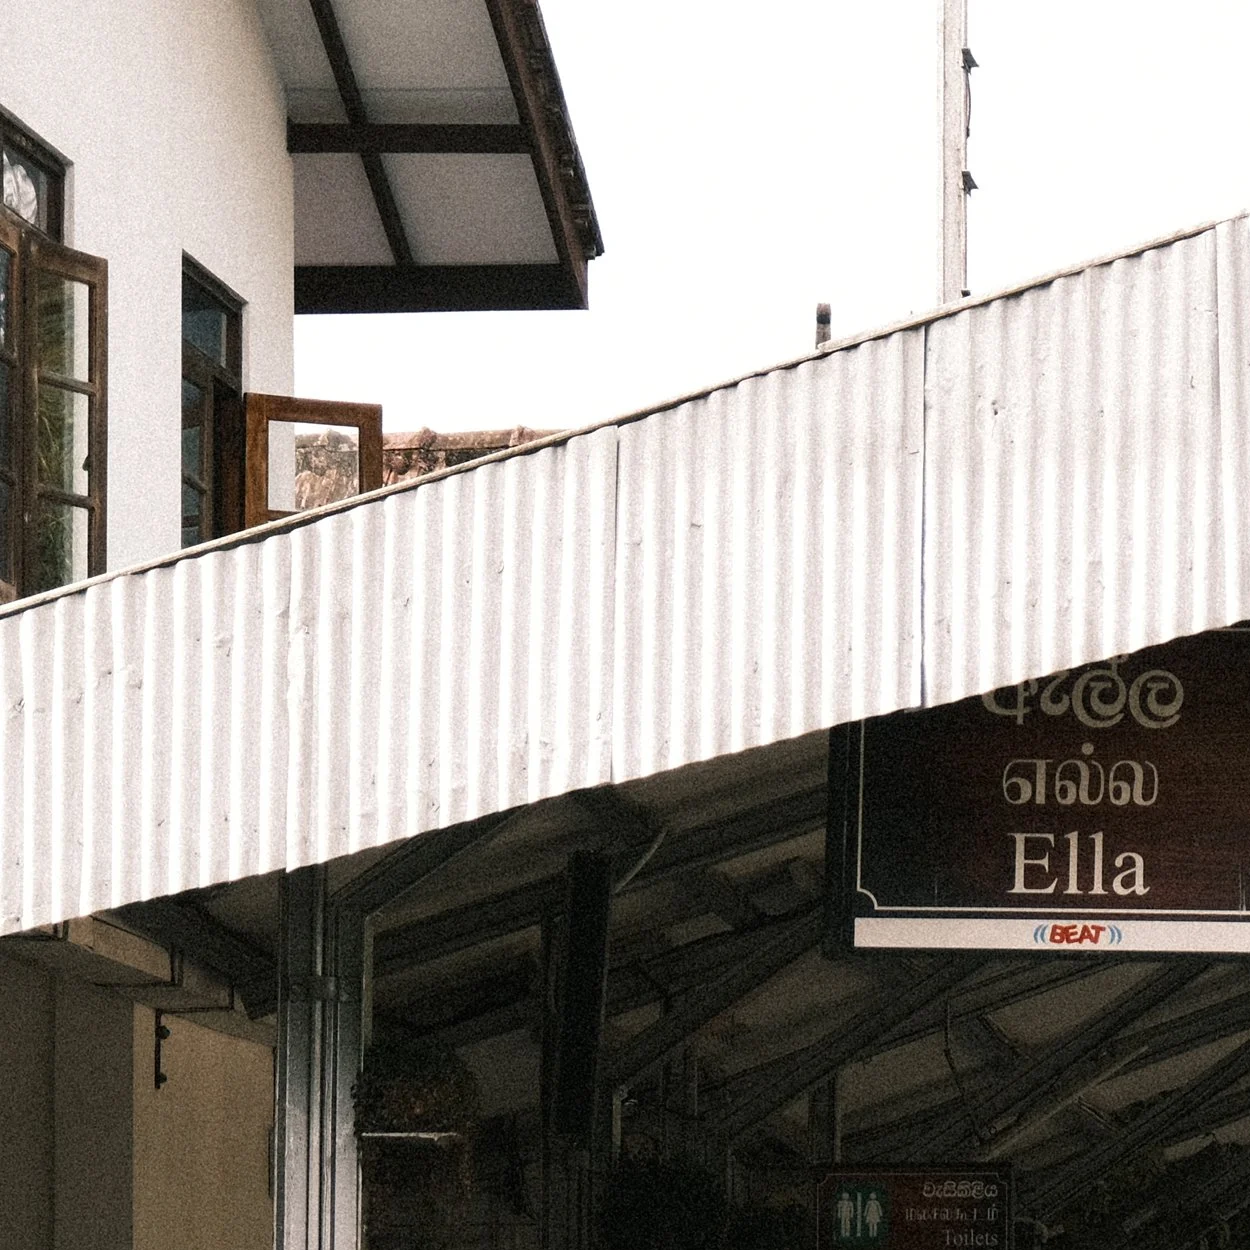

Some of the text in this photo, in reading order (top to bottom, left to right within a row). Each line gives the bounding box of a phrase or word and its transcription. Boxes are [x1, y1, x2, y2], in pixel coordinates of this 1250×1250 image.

[1003, 743, 1159, 806] எல்ல
[1007, 831, 1150, 896] Ella
[1049, 924, 1106, 944] BEAT
[940, 1229, 998, 1246] Toilets
